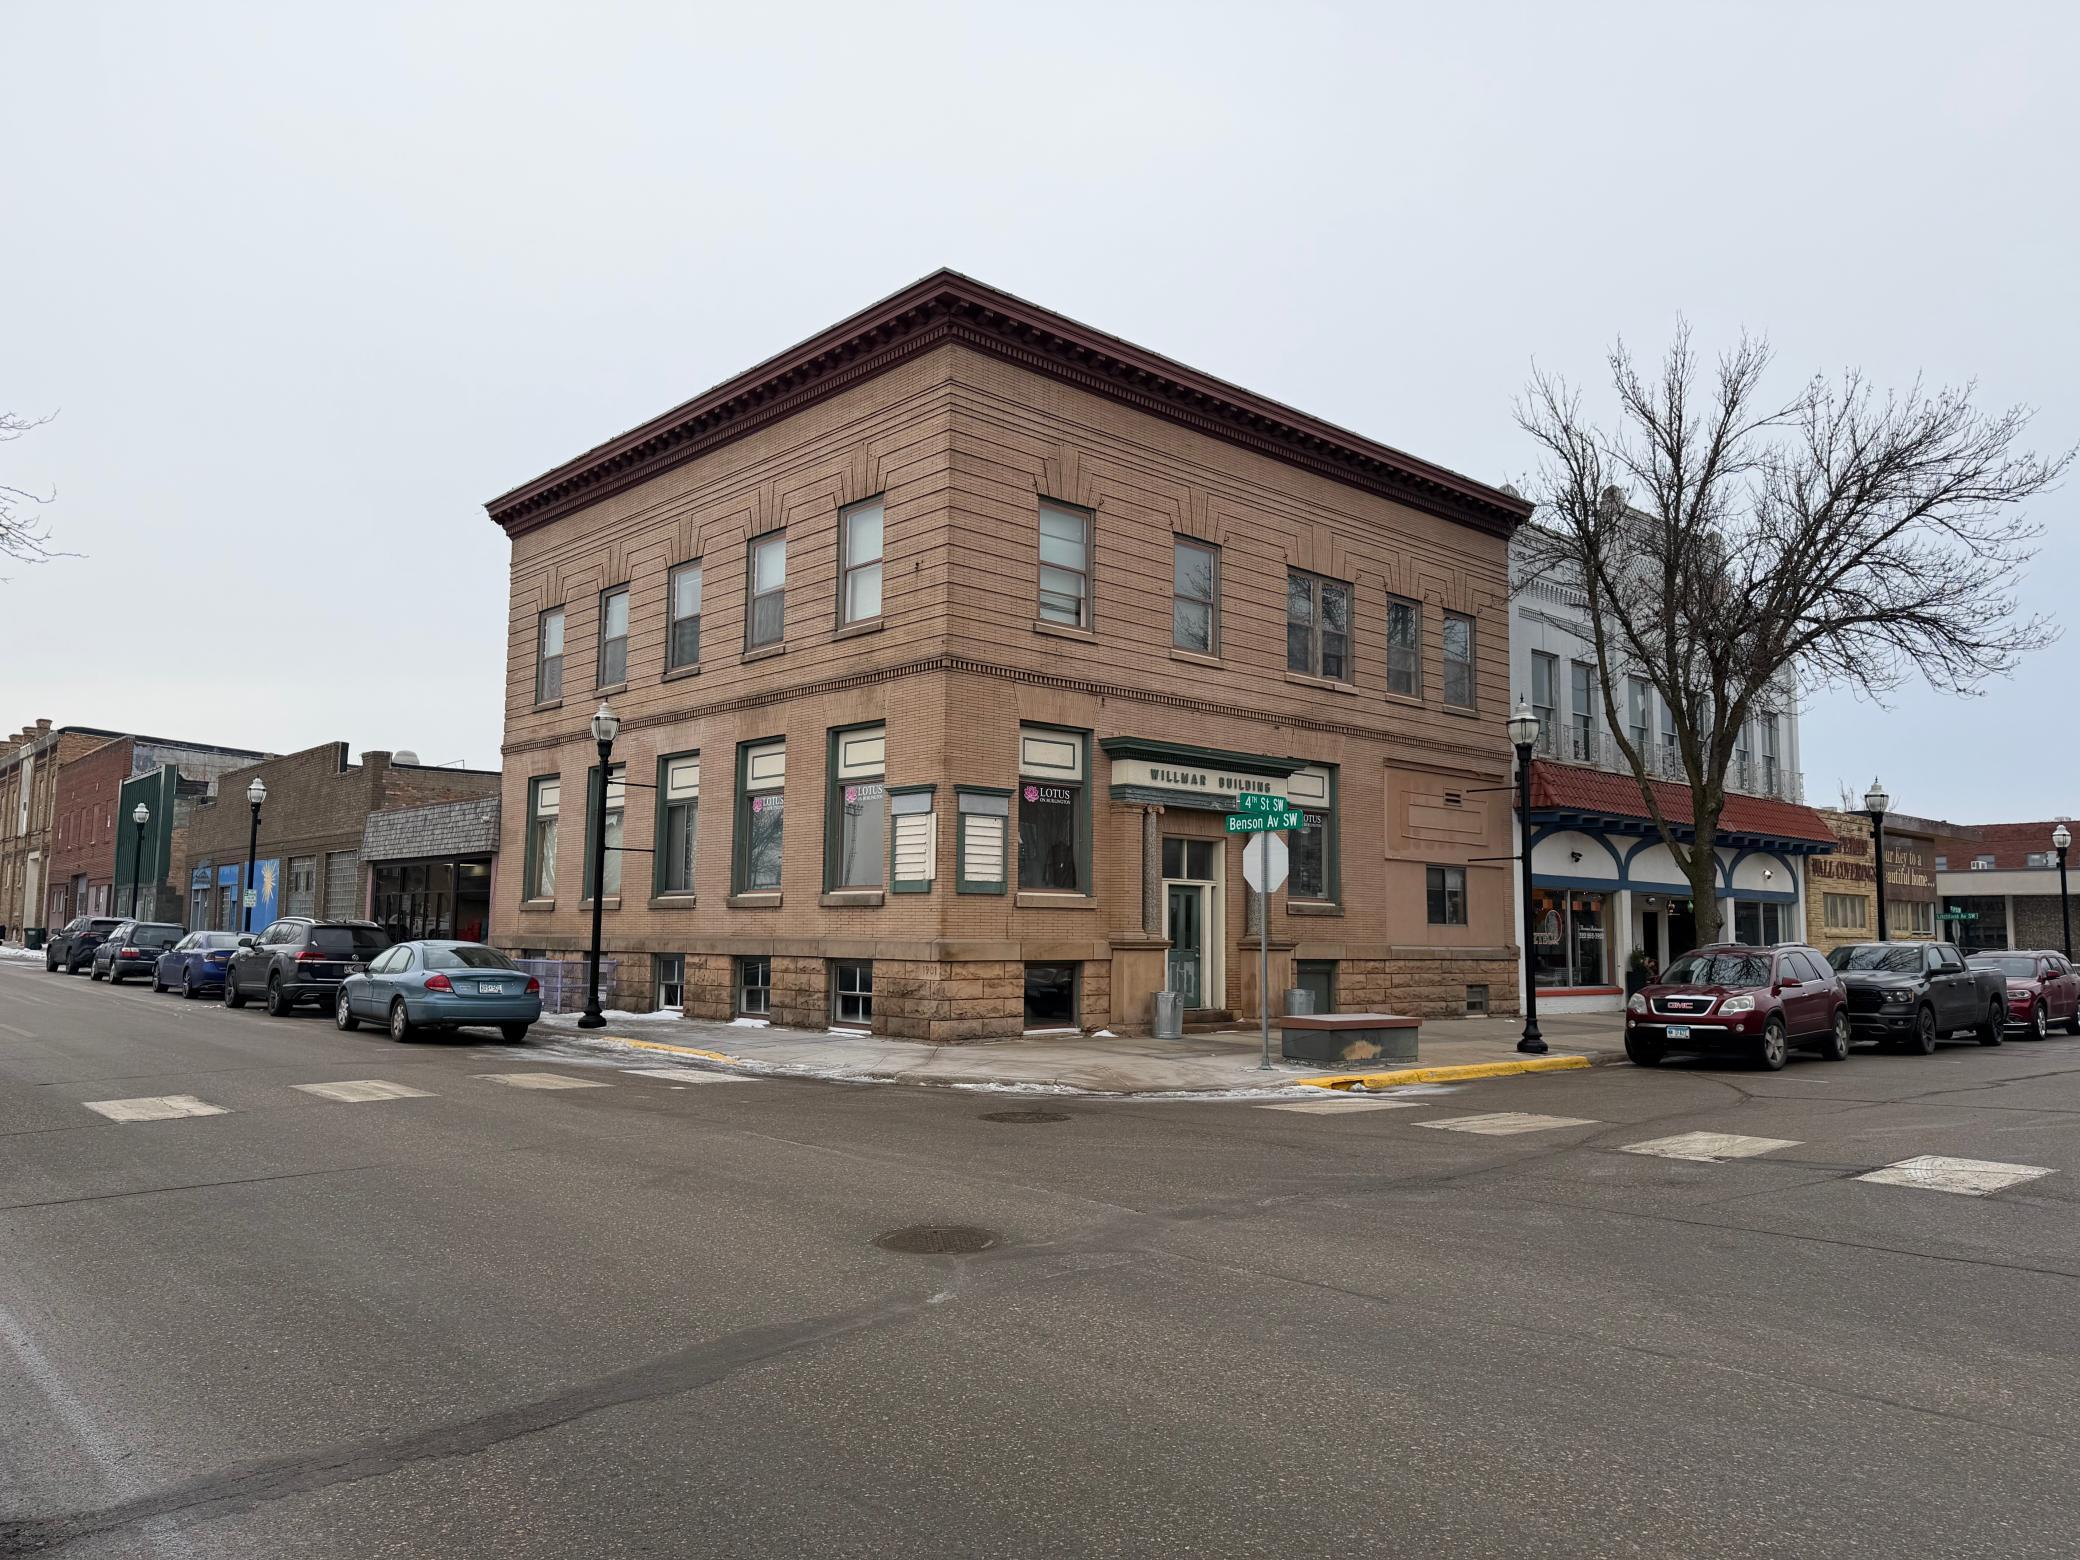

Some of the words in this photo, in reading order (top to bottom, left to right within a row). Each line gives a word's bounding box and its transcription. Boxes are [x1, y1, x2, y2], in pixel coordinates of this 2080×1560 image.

[1150, 768, 1207, 786] WILLMAR
[1218, 776, 1271, 793] BUILDING
[857, 785, 883, 796] LOTUS
[1040, 787, 1070, 799] LOTUS
[762, 795, 784, 806] LOTUS
[1244, 795, 1258, 809] 4TH
[1260, 797, 1270, 811] St
[1272, 798, 1284, 812] SW
[1229, 817, 1263, 831] Benson
[1266, 814, 1279, 828] Av
[1282, 812, 1298, 827] SW
[1303, 814, 1321, 824] OTUS
[1885, 850, 1894, 863] ur
[1909, 851, 1917, 866] to
[1917, 854, 1922, 867] a
[922, 965, 937, 976] 1901
[1667, 1001, 1694, 1009] GMC
